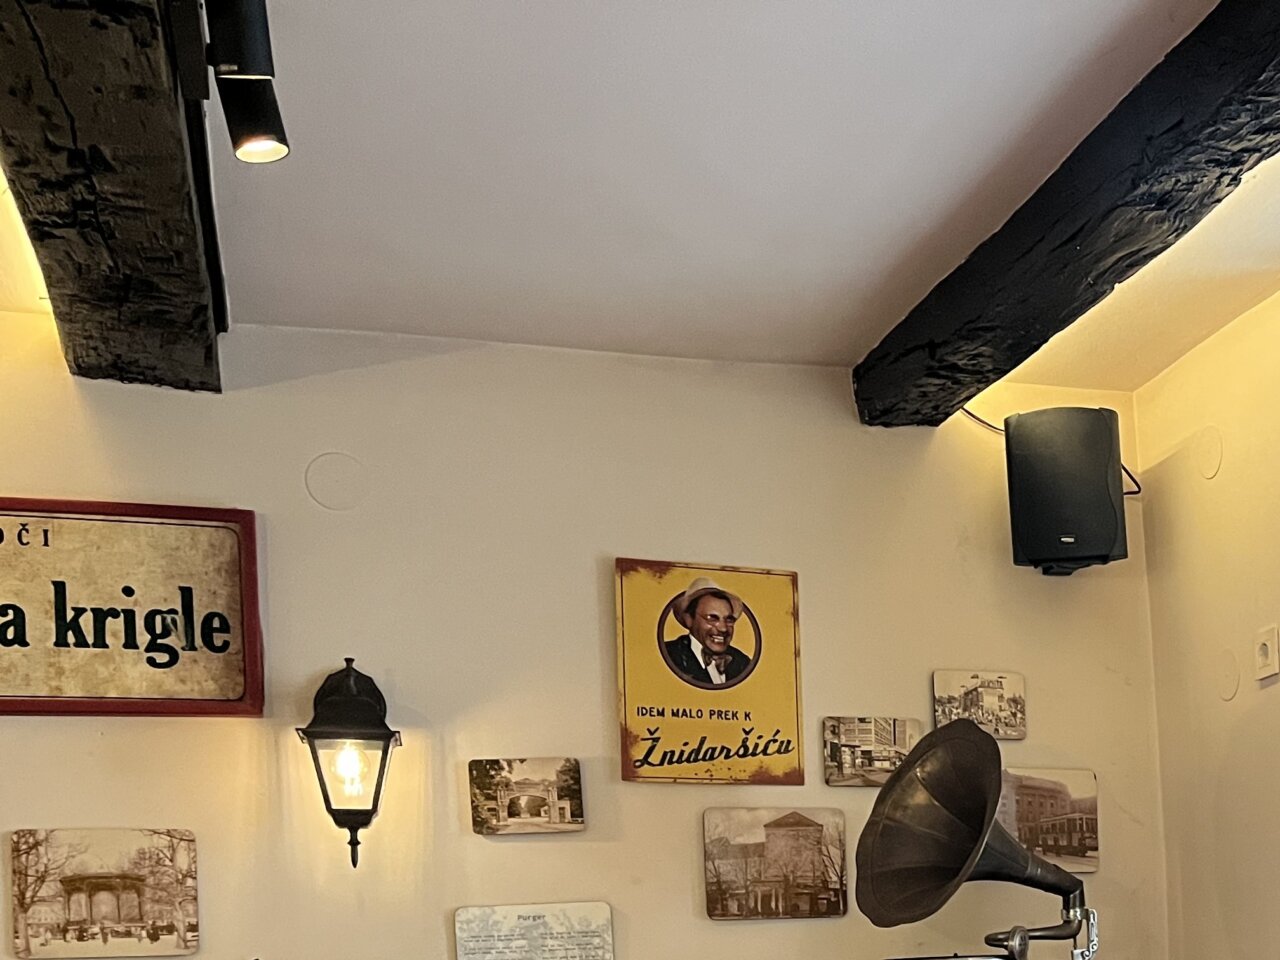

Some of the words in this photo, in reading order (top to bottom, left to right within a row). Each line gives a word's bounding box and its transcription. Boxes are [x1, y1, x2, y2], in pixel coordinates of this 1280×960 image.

[51, 580, 231, 669] krigle
[636, 706, 666, 718] IDEM
[671, 708, 704, 719] MALO
[709, 708, 739, 721] PREK
[744, 711, 752, 721] K
[633, 727, 795, 769] Žnidaršiću
